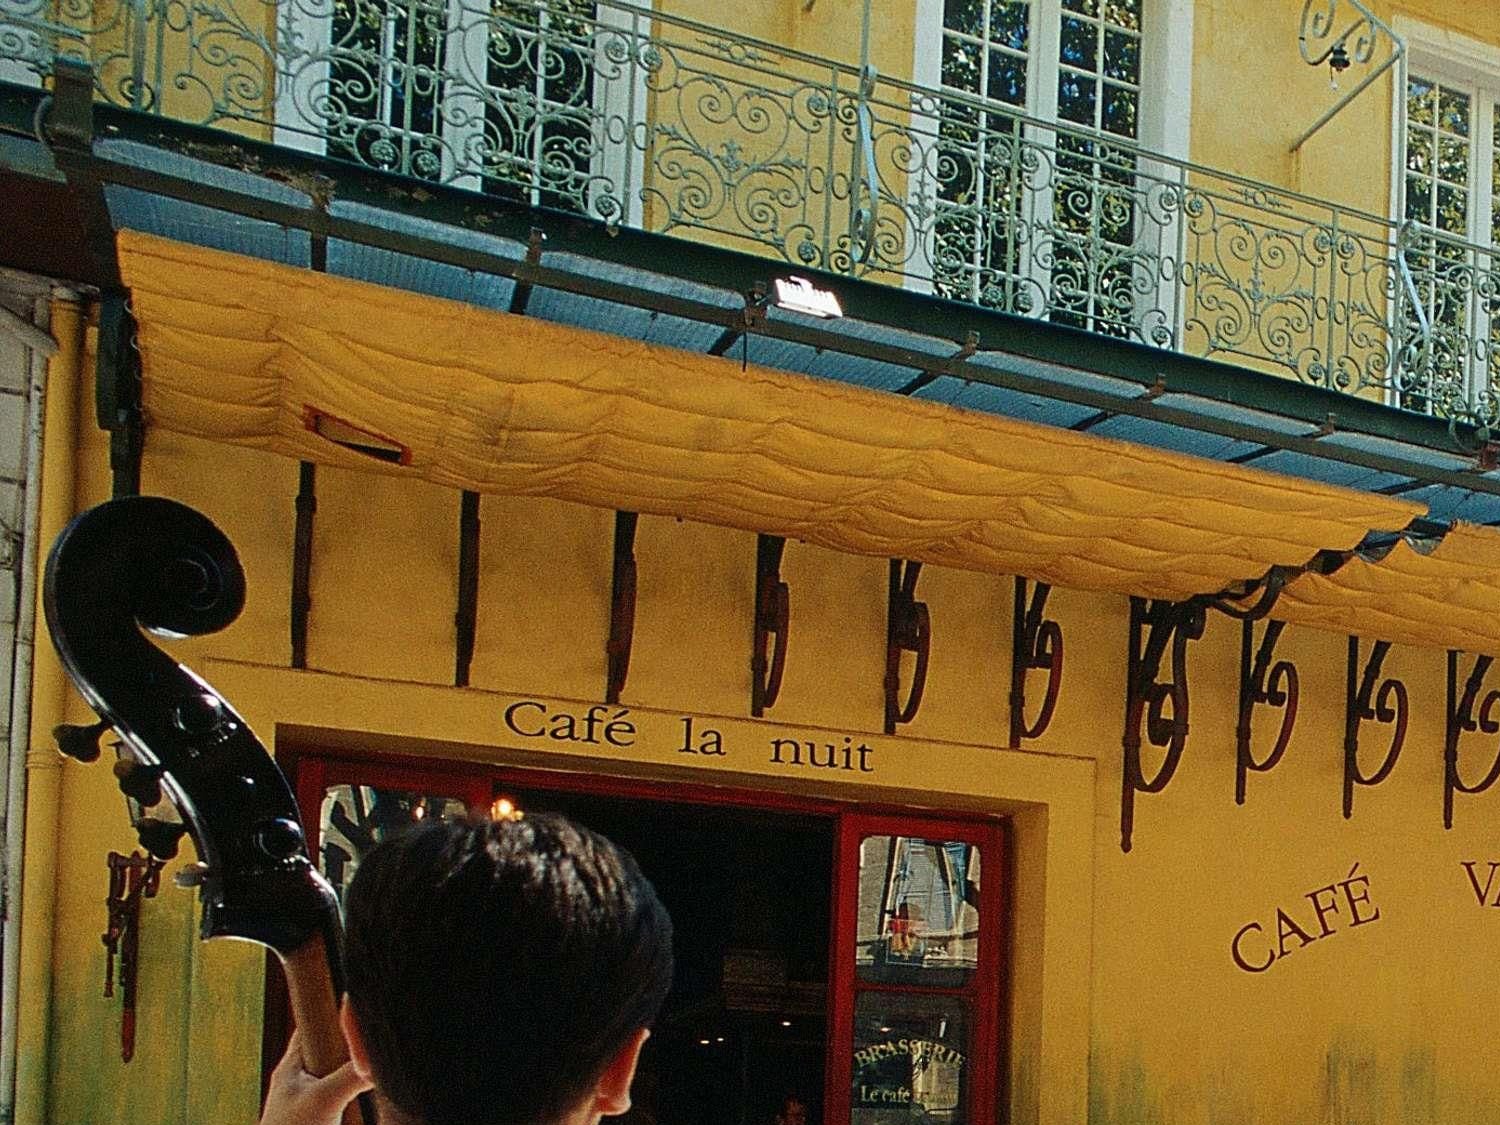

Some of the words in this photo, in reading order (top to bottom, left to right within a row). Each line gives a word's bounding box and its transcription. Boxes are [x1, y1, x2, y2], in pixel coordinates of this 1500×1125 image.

[504, 700, 637, 748] Café
[678, 716, 727, 757] la
[769, 736, 875, 773] nuit
[1230, 861, 1381, 973] CAFÉ
[854, 1038, 967, 1069] BRASSERIE
[860, 1085, 880, 1103] Le
